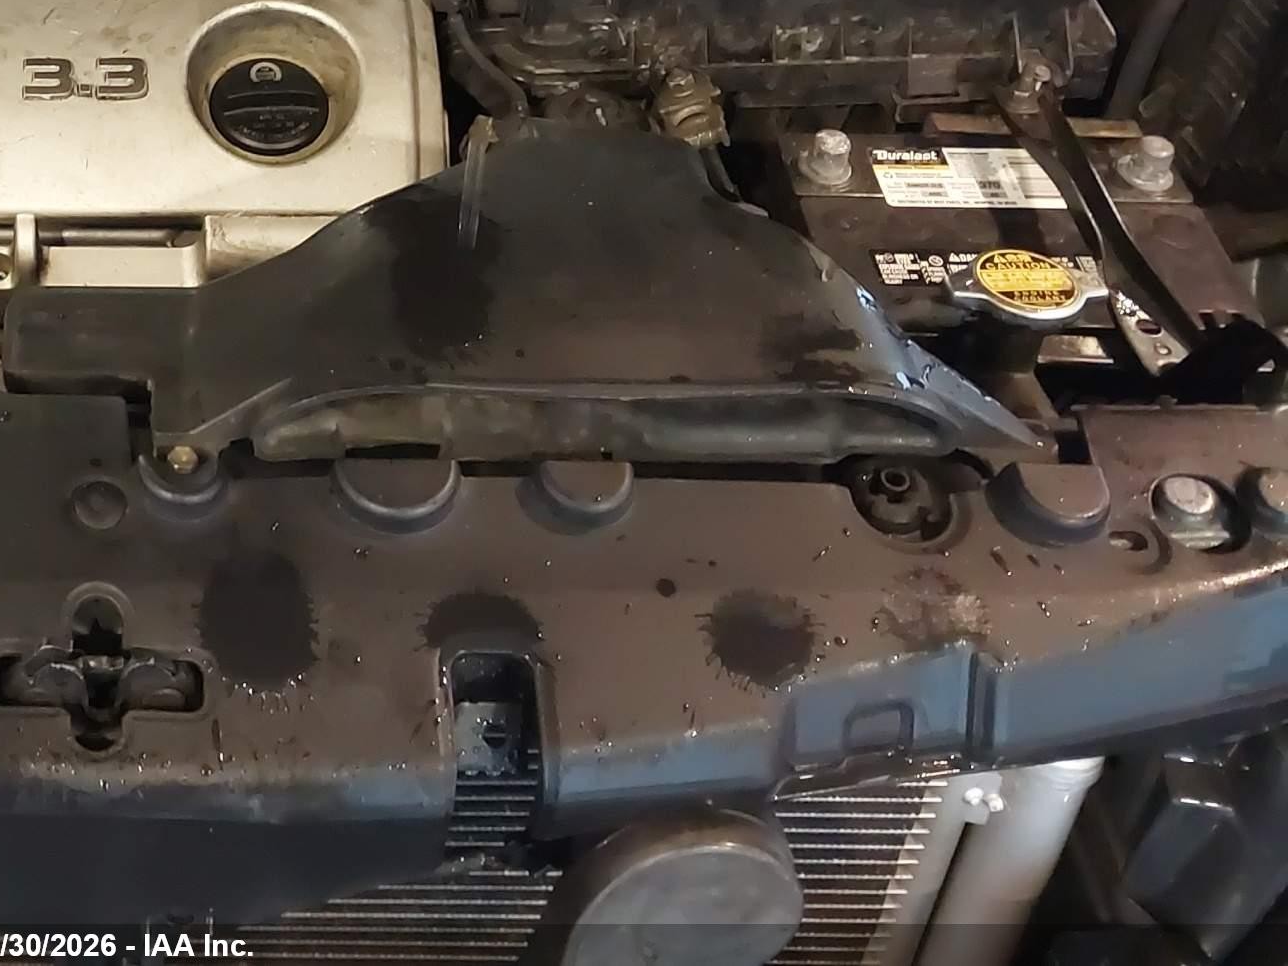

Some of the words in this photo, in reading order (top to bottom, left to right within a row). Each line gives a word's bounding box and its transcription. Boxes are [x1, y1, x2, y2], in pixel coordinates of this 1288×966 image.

[22, 57, 149, 100] 3.3
[872, 150, 938, 161] Duralast
[985, 262, 1050, 270] CAUTION
